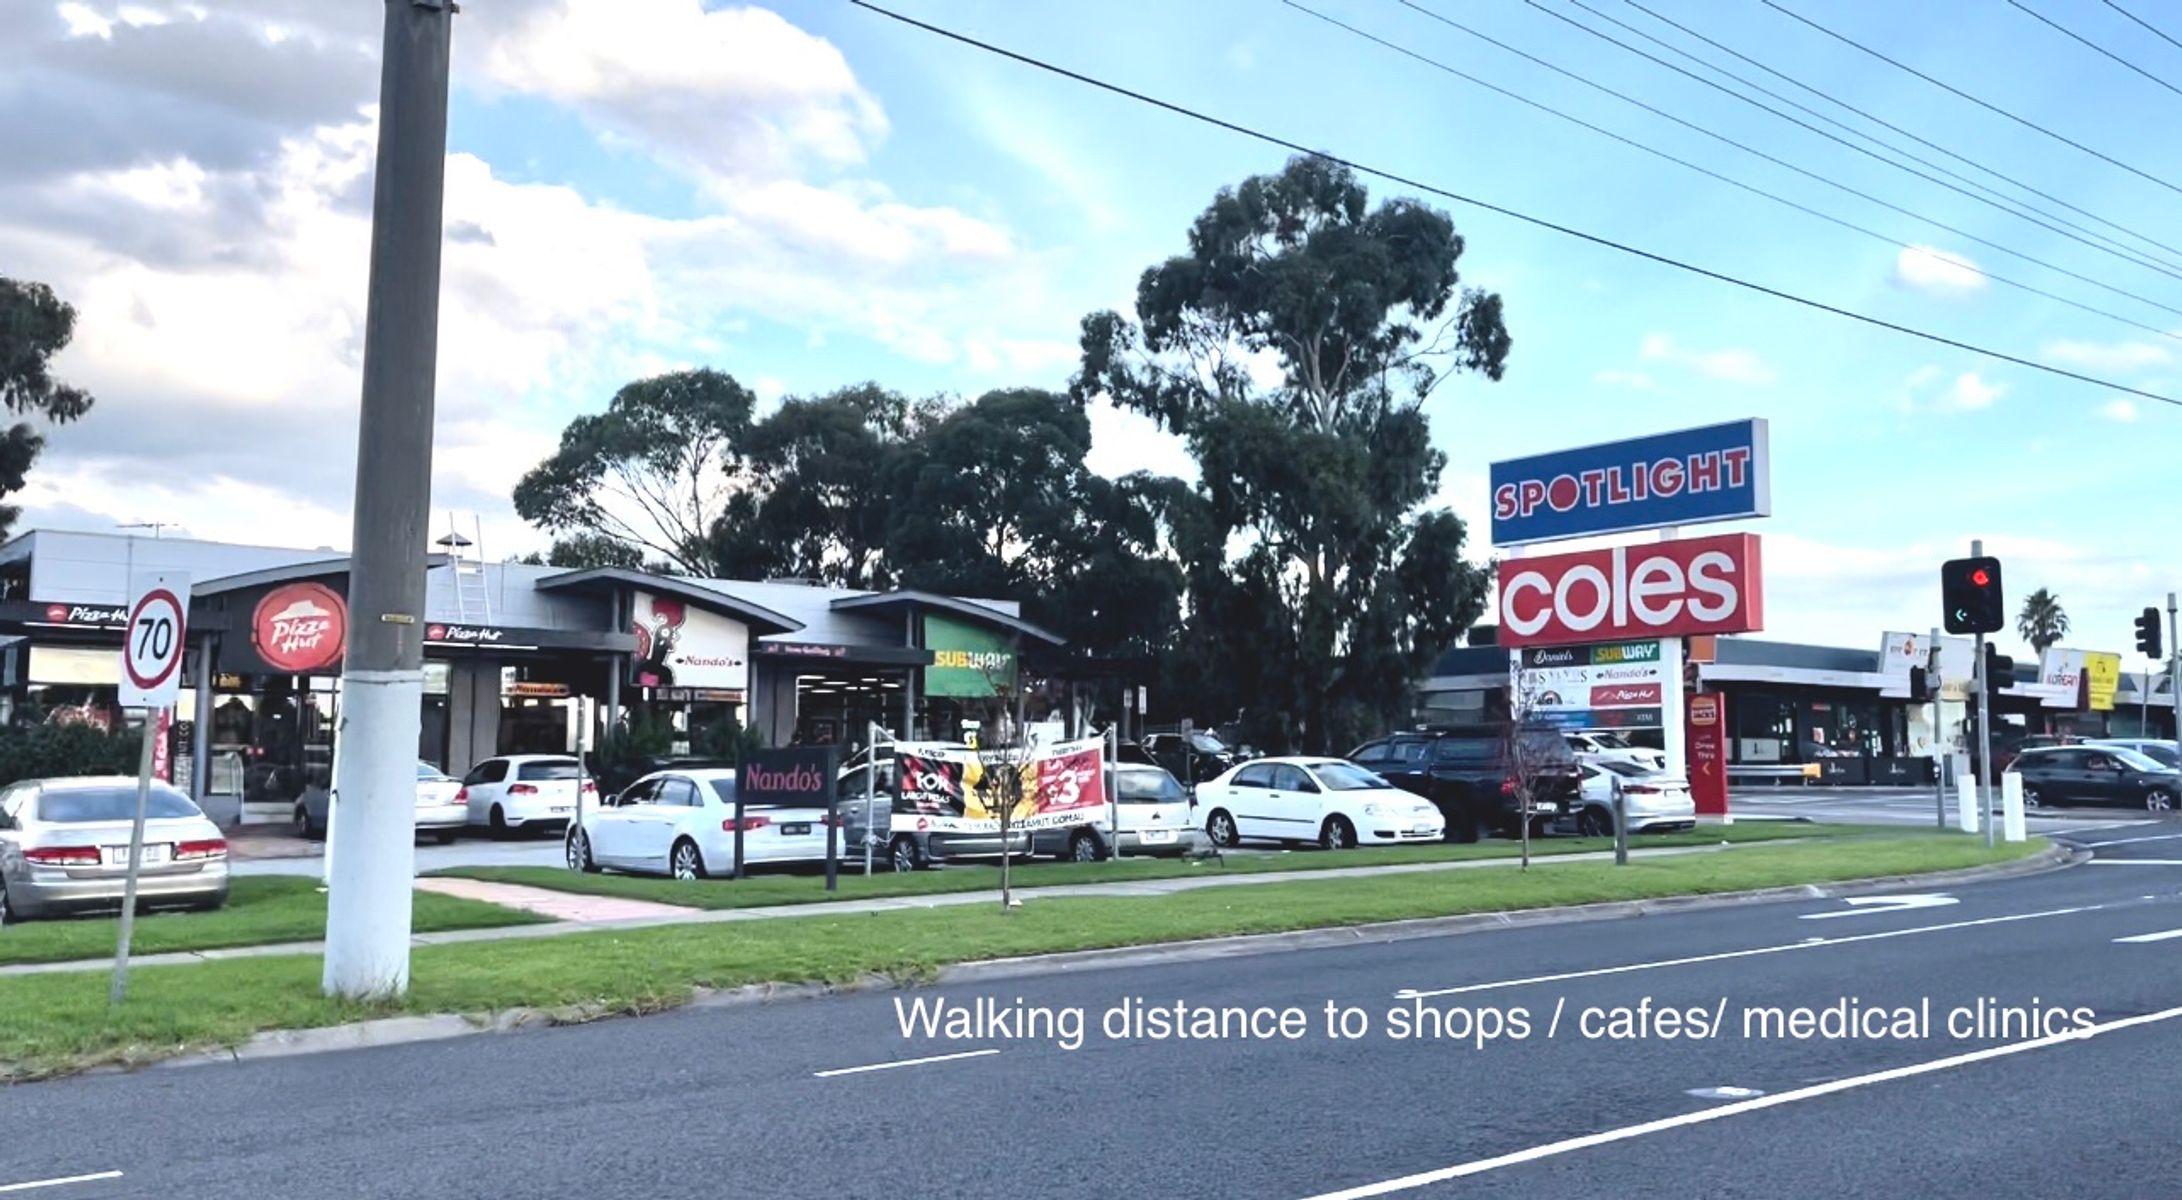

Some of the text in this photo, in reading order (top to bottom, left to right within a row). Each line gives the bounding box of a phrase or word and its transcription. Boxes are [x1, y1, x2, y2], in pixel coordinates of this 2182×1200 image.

[1494, 445, 1751, 520] SPOTLIGHT
[1502, 546, 1738, 637] coles
[68, 606, 129, 622] Pizza Hu
[138, 618, 172, 660] 70
[271, 618, 330, 646] Pizza
[445, 626, 503, 641] Pizza Hut
[281, 633, 323, 654] Hut
[1597, 643, 1657, 661] SUBWAY
[684, 655, 735, 668] Nando's
[1604, 668, 1649, 680] Nando's
[745, 763, 822, 792] Nando's
